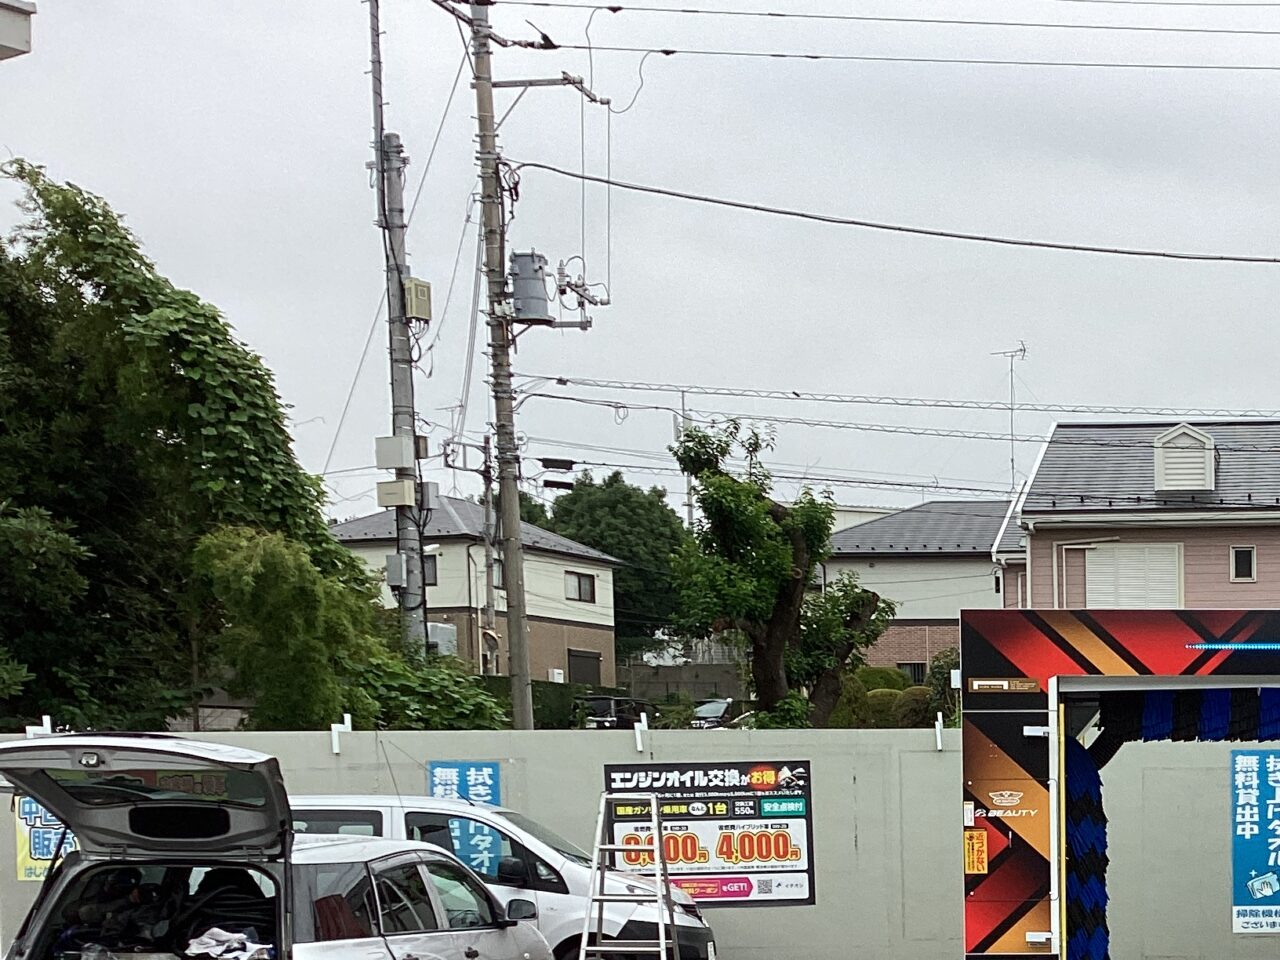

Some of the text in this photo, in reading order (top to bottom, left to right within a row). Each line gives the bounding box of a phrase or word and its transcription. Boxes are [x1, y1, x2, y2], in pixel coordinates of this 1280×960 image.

[987, 809, 1038, 817] BEAUTY
[1234, 754, 1260, 840] 無料貸出中
